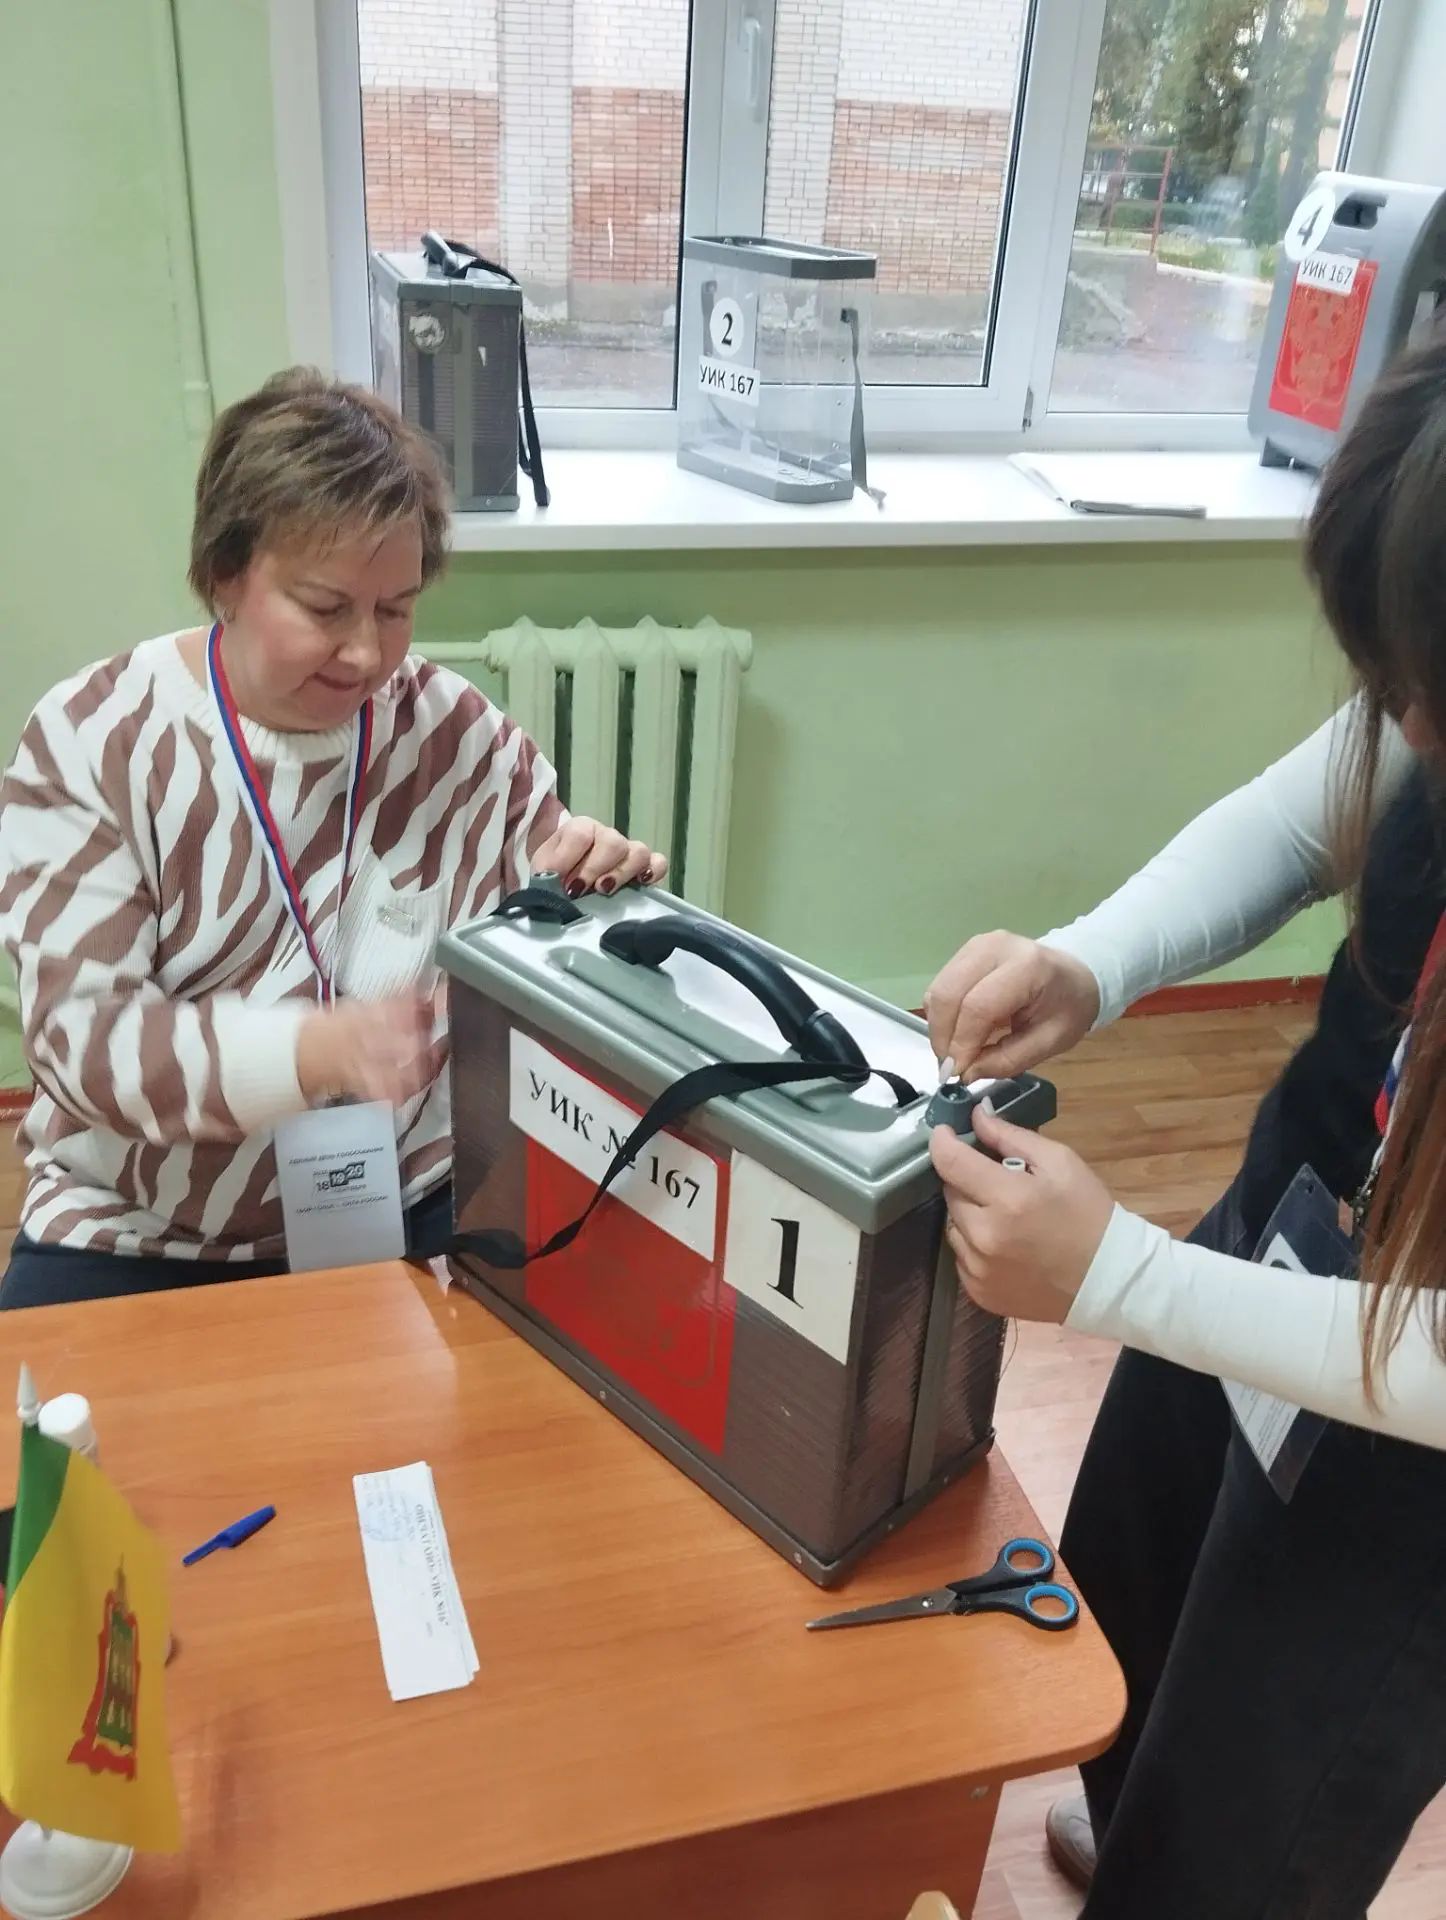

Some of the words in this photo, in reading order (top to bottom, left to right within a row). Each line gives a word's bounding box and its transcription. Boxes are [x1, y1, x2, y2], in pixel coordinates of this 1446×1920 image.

[1298, 205, 1324, 246] 4
[1302, 259, 1327, 279] УИК
[1329, 265, 1353, 285] 167
[721, 312, 734, 346] 2
[700, 364, 726, 390] УИК
[730, 373, 754, 396] 167
[528, 1068, 594, 1141] УИК
[648, 1155, 700, 1209] 167
[766, 1217, 804, 1310] 1
